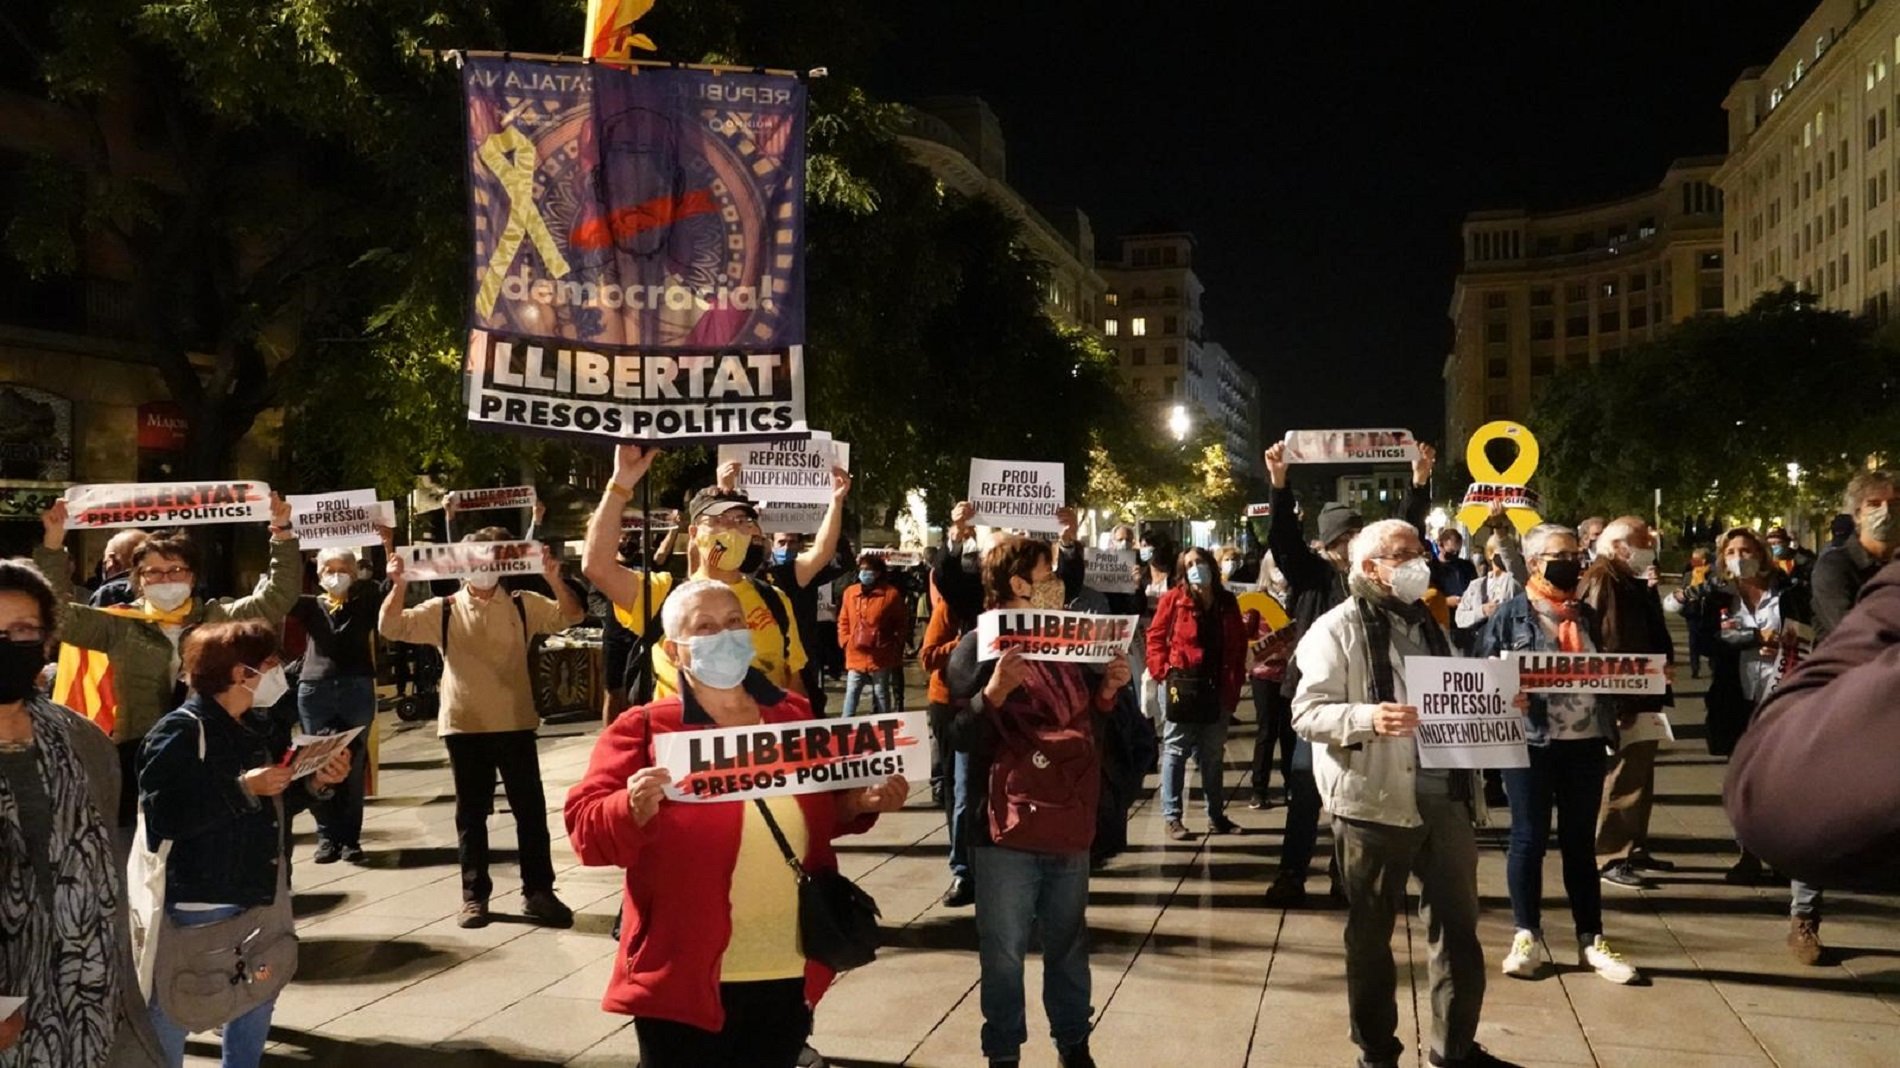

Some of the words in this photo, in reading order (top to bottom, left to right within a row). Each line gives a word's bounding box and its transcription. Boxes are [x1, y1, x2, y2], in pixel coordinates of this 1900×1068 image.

[502, 264, 773, 311] democràcia!
[493, 341, 781, 400] LLIBERTAT
[480, 394, 623, 432] PRESOS
[633, 402, 793, 435] POLÍTICS
[749, 450, 825, 469] REPRESSIÓ:
[1001, 469, 1038, 484] PROU
[88, 483, 250, 509] BERTAT
[981, 482, 1056, 498] REPRESSIÓ:
[87, 509, 160, 524] PRESOS
[299, 506, 369, 525] REPRESSIÓ:
[316, 498, 350, 512] PROU
[1519, 655, 1649, 675] LLIBERTAT
[1443, 671, 1484, 693] PROU
[1423, 687, 1507, 715] REPRESSIÓ:
[1418, 717, 1522, 744] INDEPENDÈNCIA
[689, 719, 899, 774] LLIBERTAT
[691, 768, 787, 796] PRESOS
[797, 754, 905, 785] POLÍTICS!
